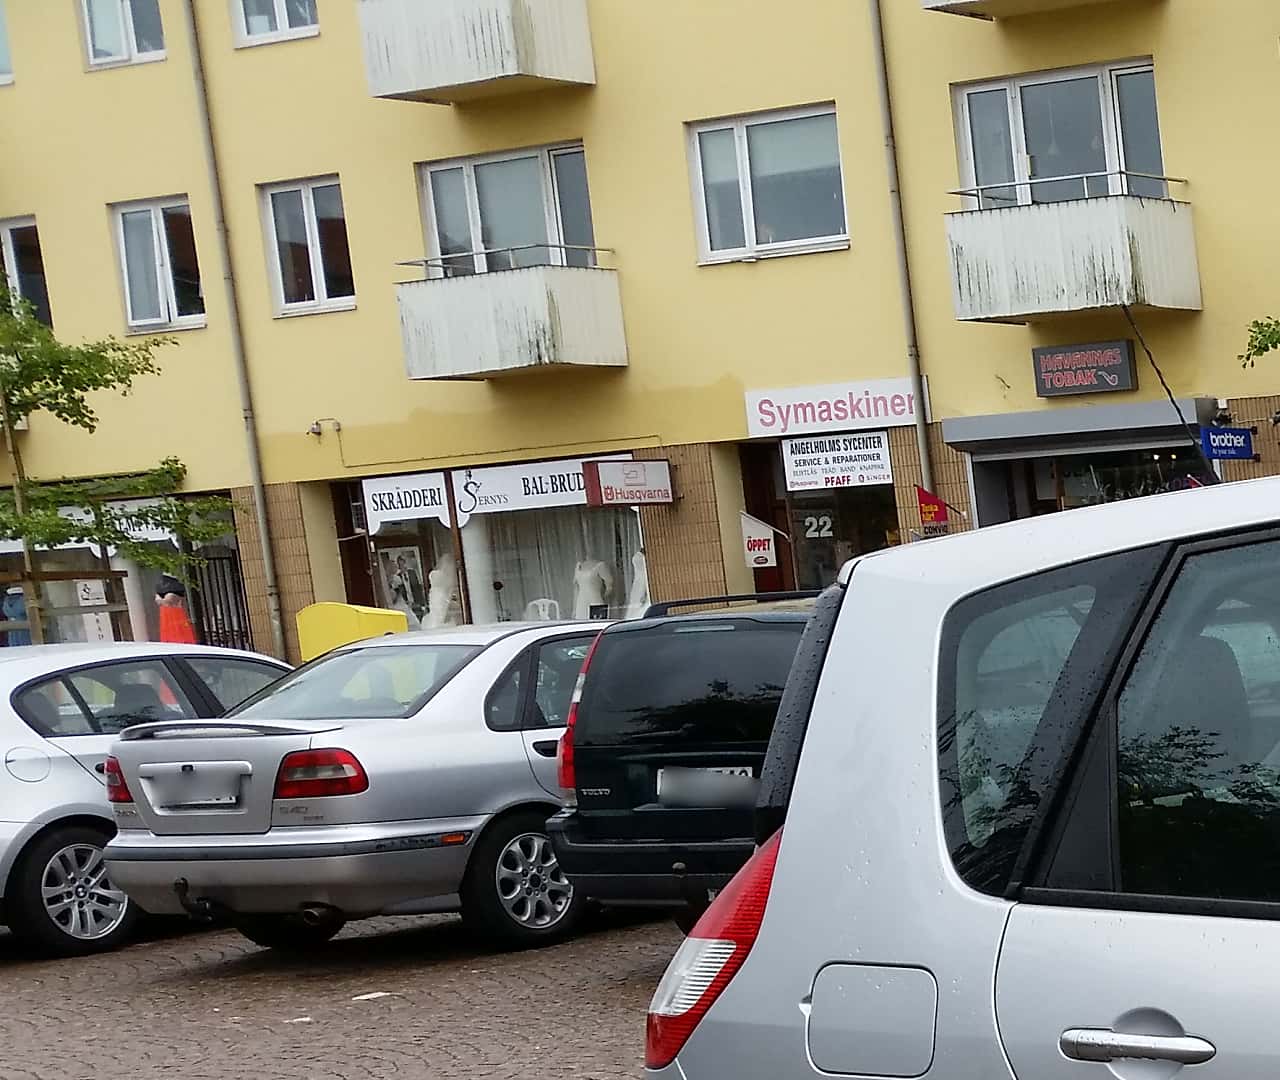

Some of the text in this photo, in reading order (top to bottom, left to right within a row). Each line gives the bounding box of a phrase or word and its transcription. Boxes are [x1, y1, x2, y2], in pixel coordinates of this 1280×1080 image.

[1040, 348, 1121, 372] HAVANNAS
[1041, 369, 1097, 388] TOBAK
[758, 391, 914, 433] Symaskiner
[790, 436, 882, 456] ÄNGELHOLMS SYCENTER
[1209, 431, 1244, 447] brother
[794, 453, 881, 467] SERVICE & REPARATIONER
[824, 475, 851, 486] PFAFF
[371, 486, 442, 512] SKRÄDDERI
[615, 487, 670, 502] Husqvarna
[805, 516, 833, 538] 22
[747, 536, 771, 552] ÖPPET
